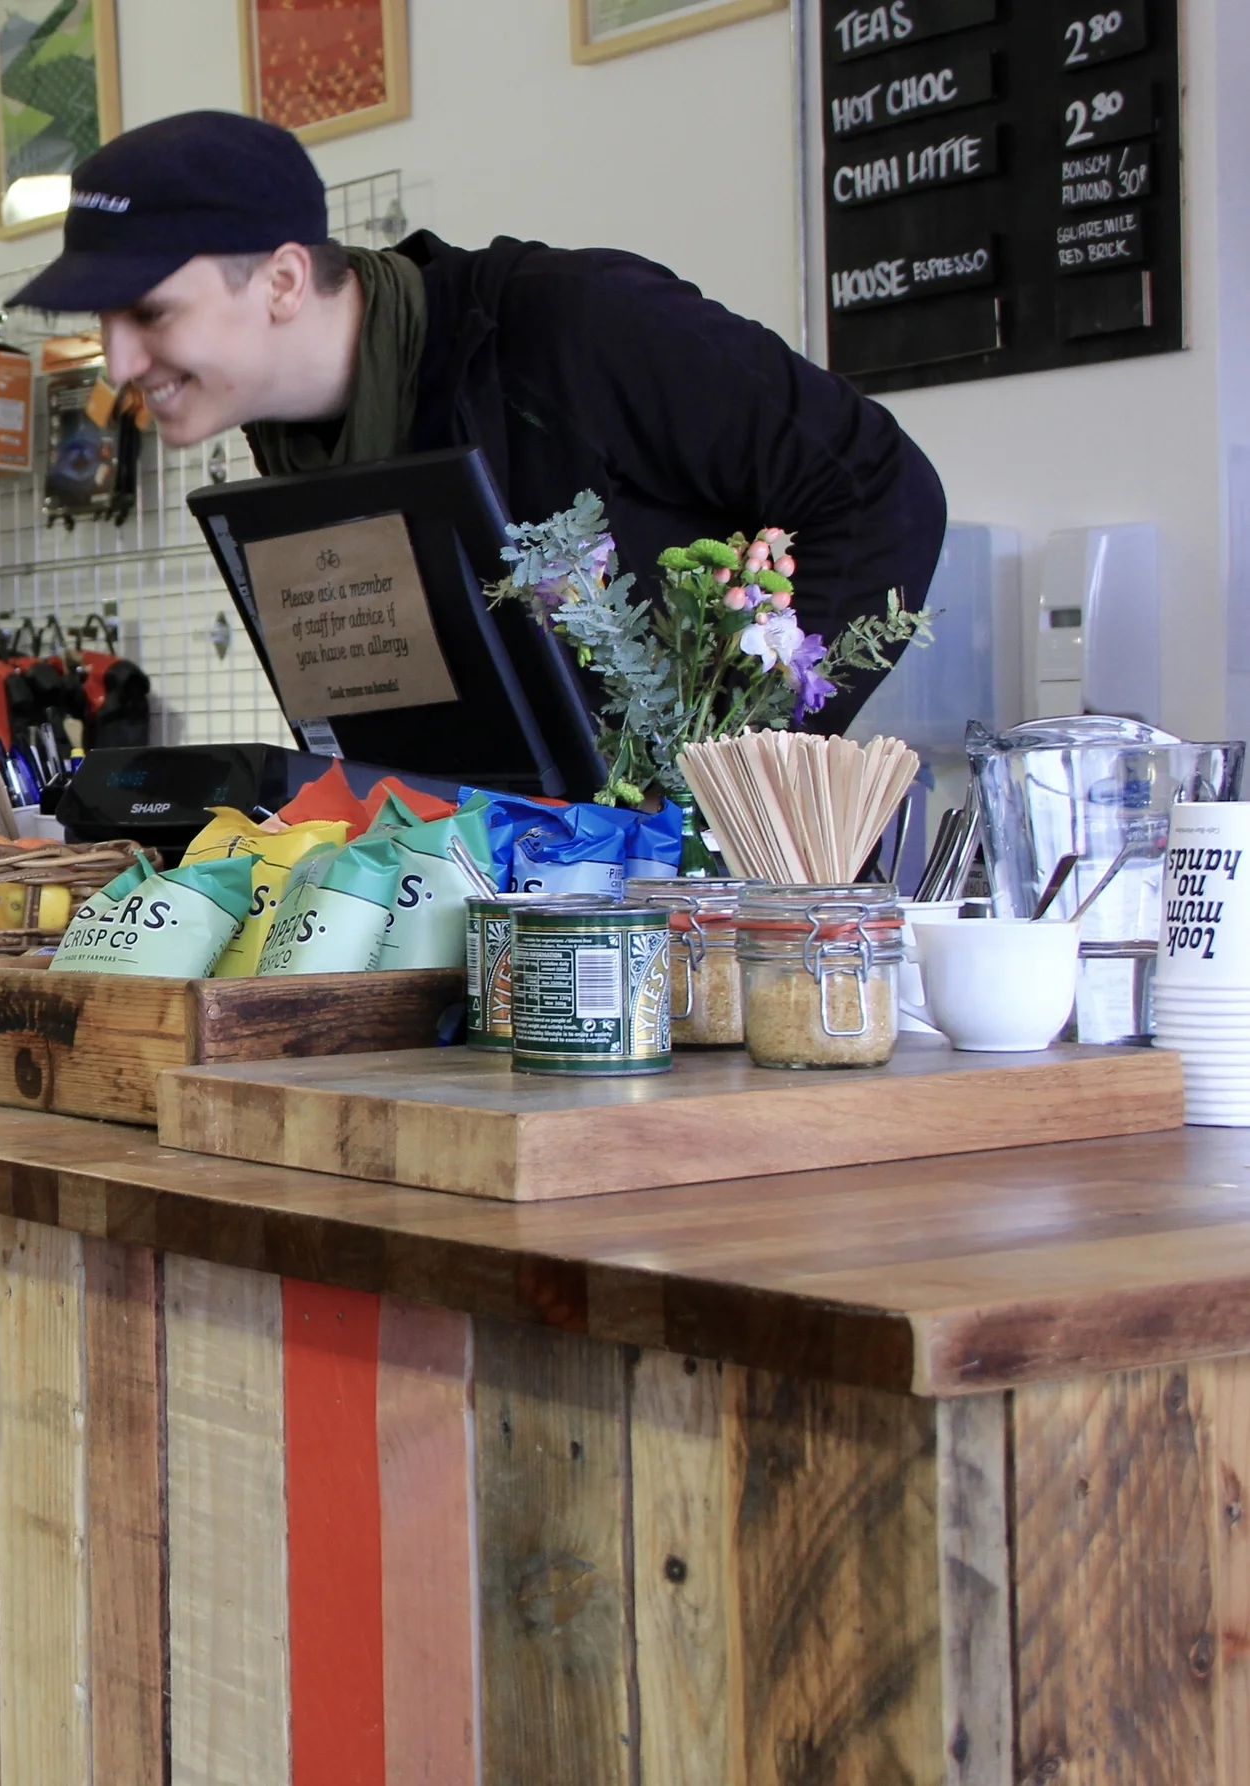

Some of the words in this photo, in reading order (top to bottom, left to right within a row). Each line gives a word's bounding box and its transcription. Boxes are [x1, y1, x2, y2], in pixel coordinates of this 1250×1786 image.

[835, 0, 913, 52] TEAS
[832, 84, 881, 132] HOT
[886, 69, 958, 117] CHOC
[833, 156, 899, 203] CHAI
[908, 135, 982, 183] LATTE
[1062, 154, 1112, 181] BONSOY
[1062, 179, 1112, 205] ALMOND
[1058, 247, 1084, 266] RED
[1087, 239, 1131, 262] BRICK
[832, 259, 909, 308] HOUSE
[913, 249, 988, 282] ESPRESSO
[281, 588, 315, 608] Please
[318, 582, 336, 602] ask
[339, 585, 347, 599] a
[349, 573, 393, 597] member
[292, 617, 302, 641] of
[305, 612, 329, 638] staff
[330, 611, 346, 636] for
[349, 607, 384, 628] advice
[387, 601, 396, 627] if
[296, 650, 318, 671] you
[319, 644, 347, 662] have
[350, 643, 365, 658] an
[368, 635, 409, 658] allergy
[130, 803, 170, 813] SHARP
[1169, 848, 1243, 881] hands
[1177, 874, 1207, 898] no
[1166, 900, 1224, 925] mum
[64, 929, 107, 948] CRISP
